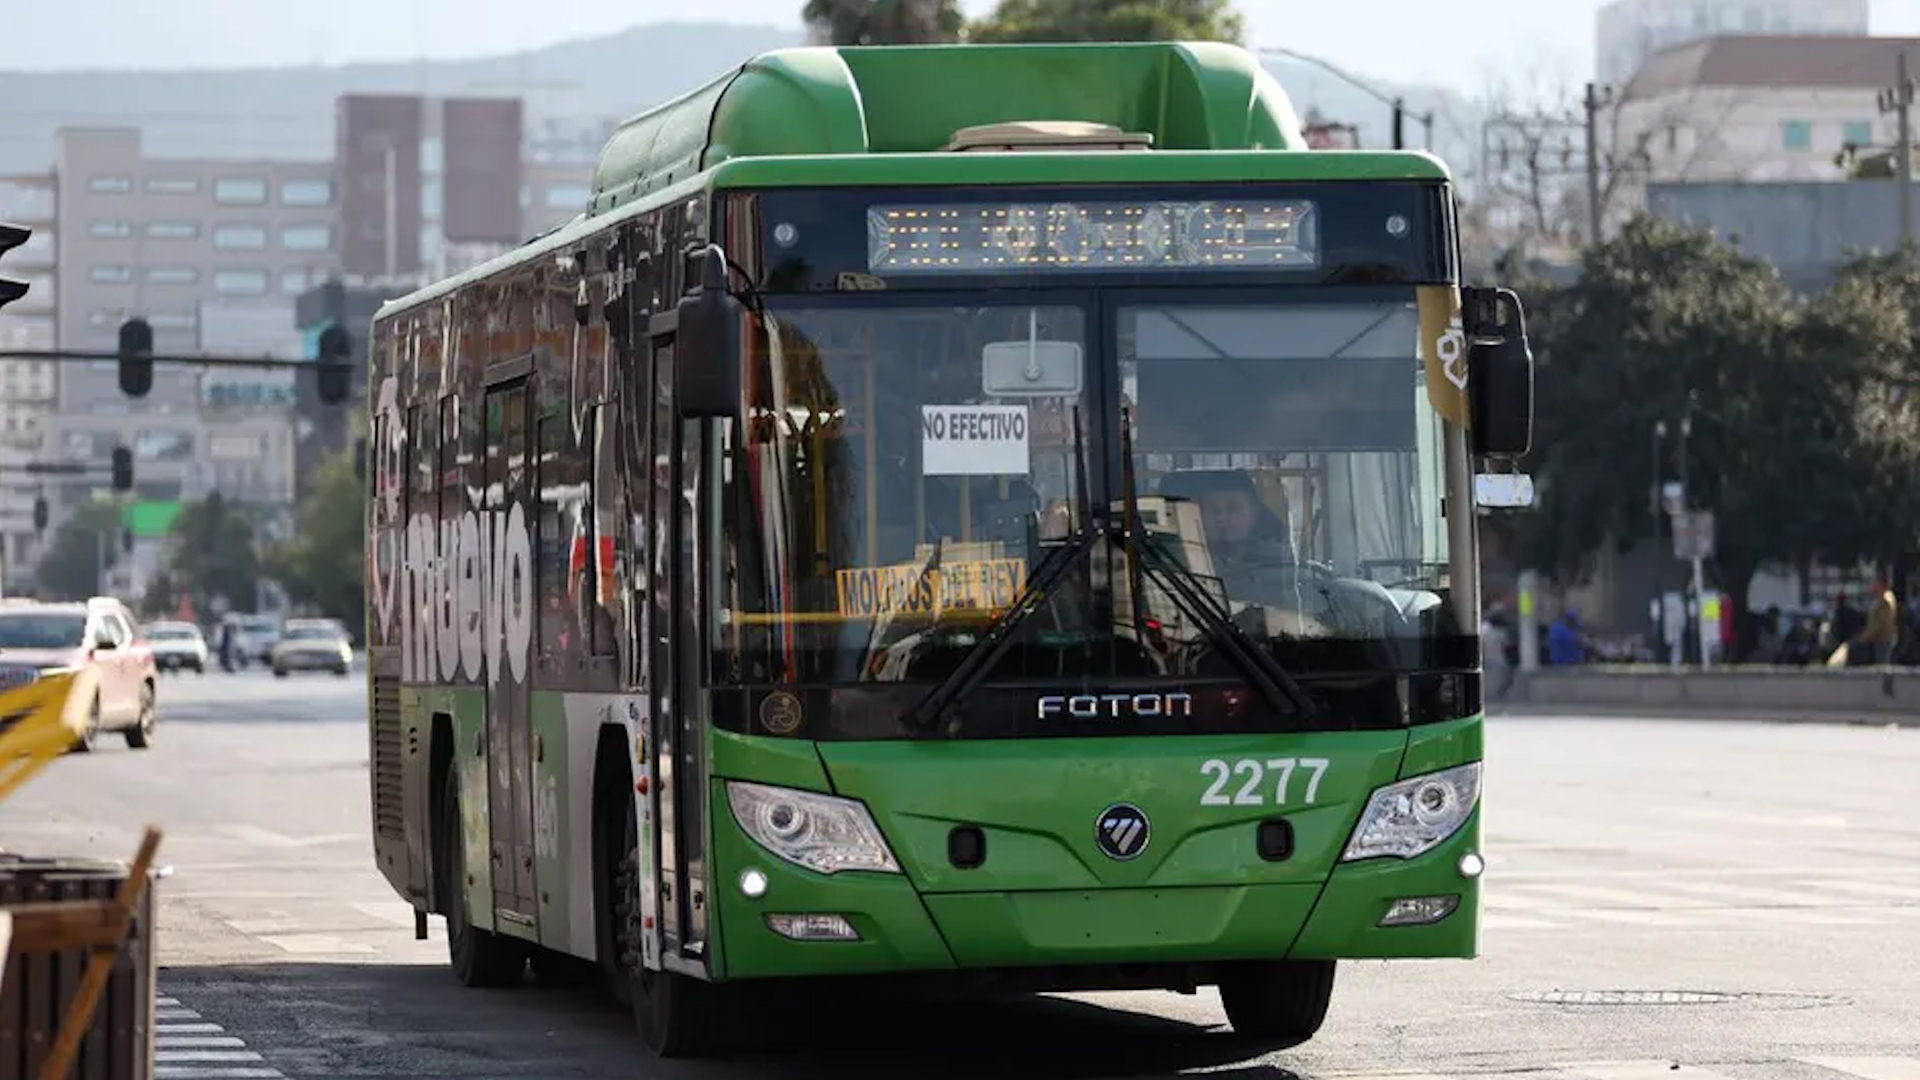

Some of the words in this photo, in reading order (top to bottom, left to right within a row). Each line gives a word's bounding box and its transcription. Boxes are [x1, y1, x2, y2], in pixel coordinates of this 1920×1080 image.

[922, 412, 945, 440] NO
[949, 412, 1025, 440] EFECTIVO
[980, 560, 1021, 606] REY
[1038, 693, 1192, 719] FOTON
[1200, 757, 1330, 805] 2277
